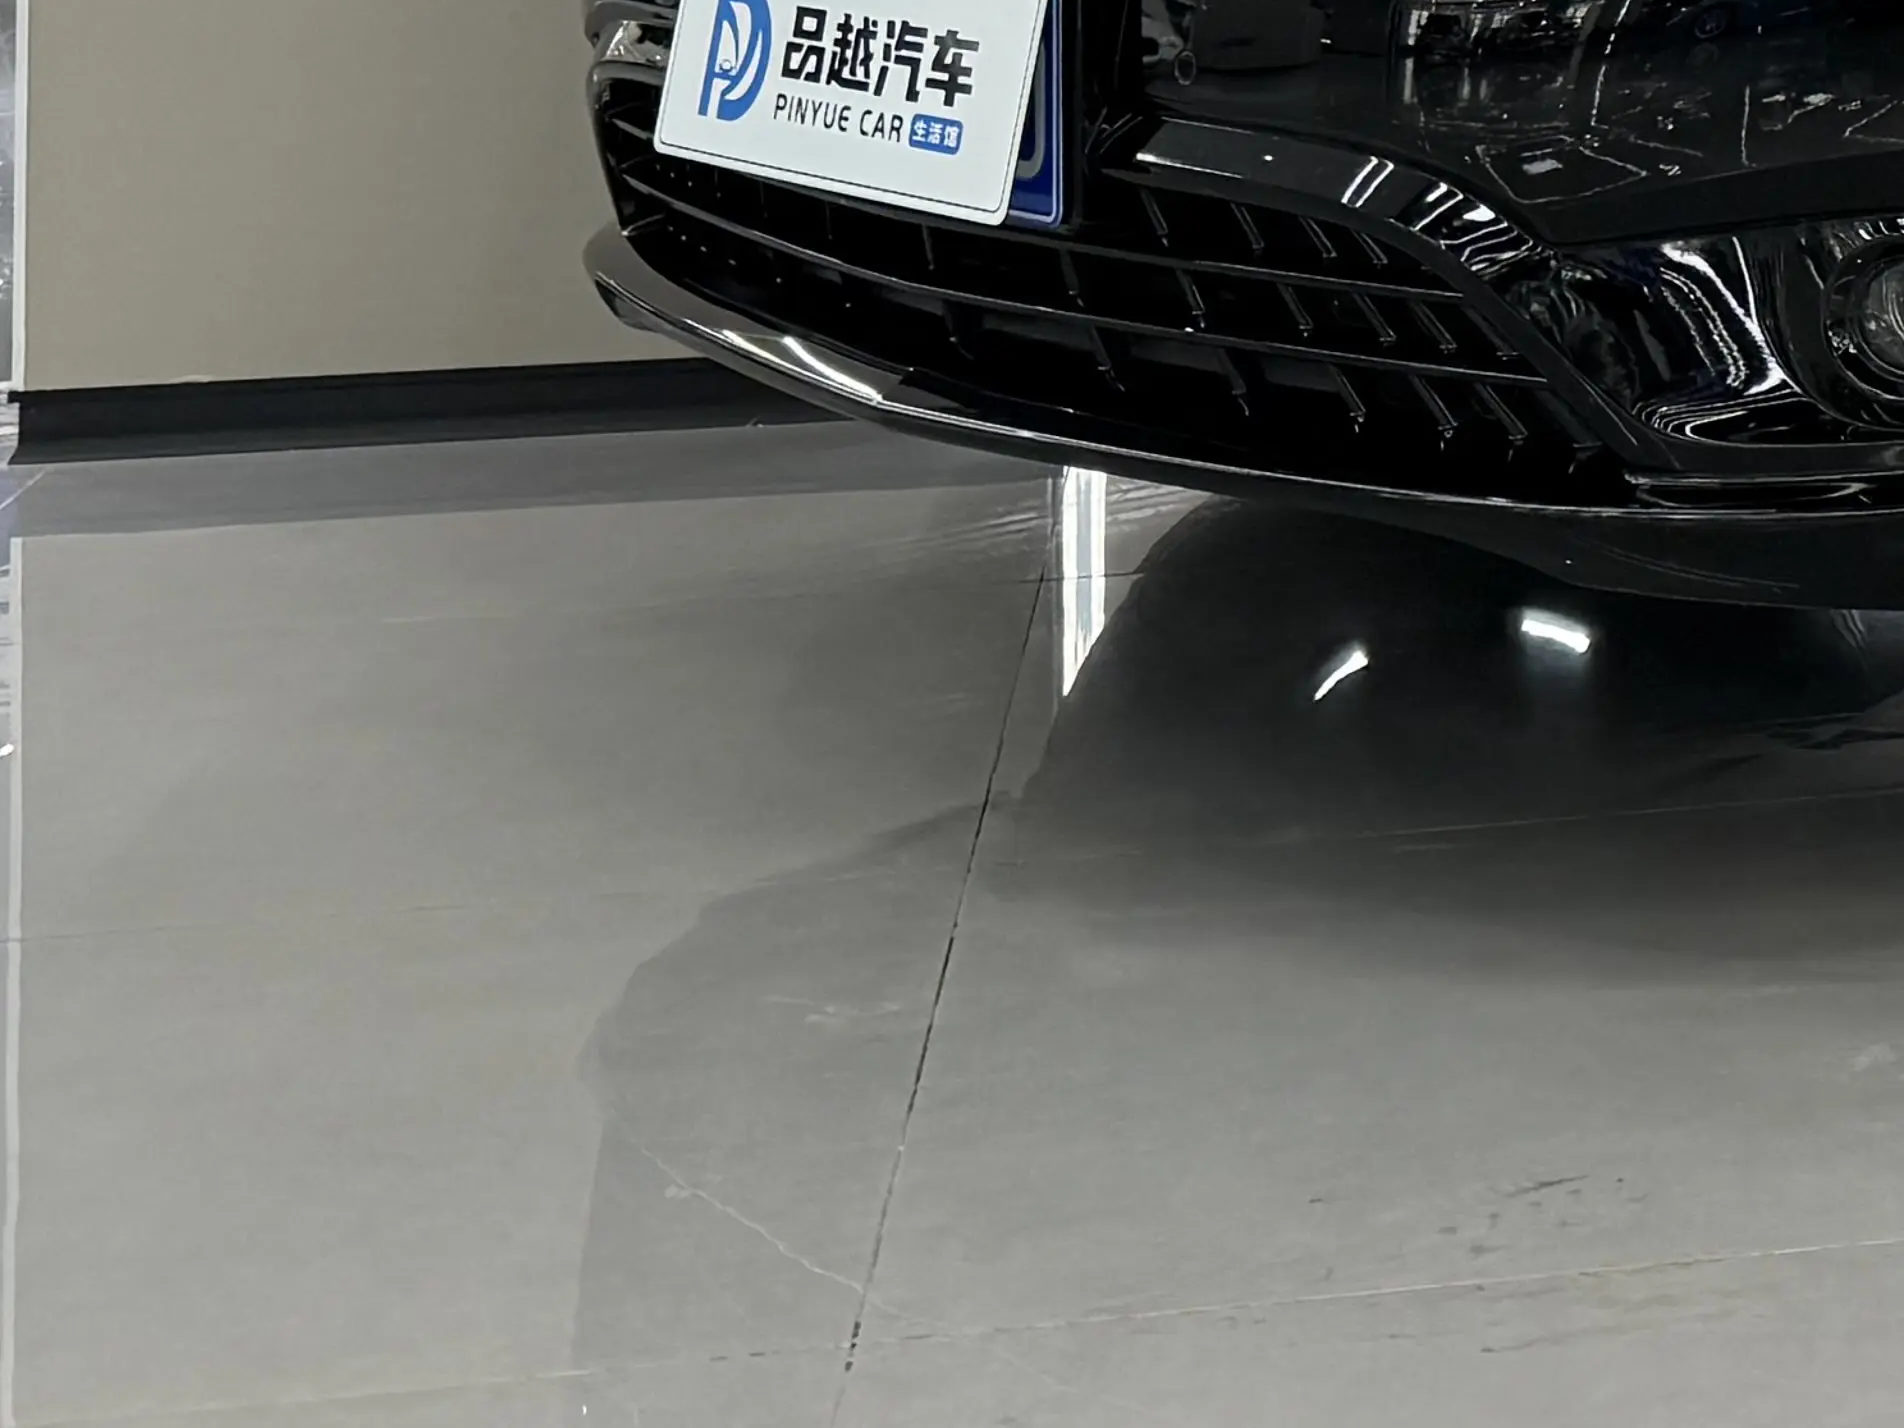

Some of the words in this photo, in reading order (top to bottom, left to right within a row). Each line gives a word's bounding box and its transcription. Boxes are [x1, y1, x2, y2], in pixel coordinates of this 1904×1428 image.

[780, 5, 981, 108] 品越汽车
[773, 94, 852, 132] PINYUE
[859, 109, 906, 144] CAR
